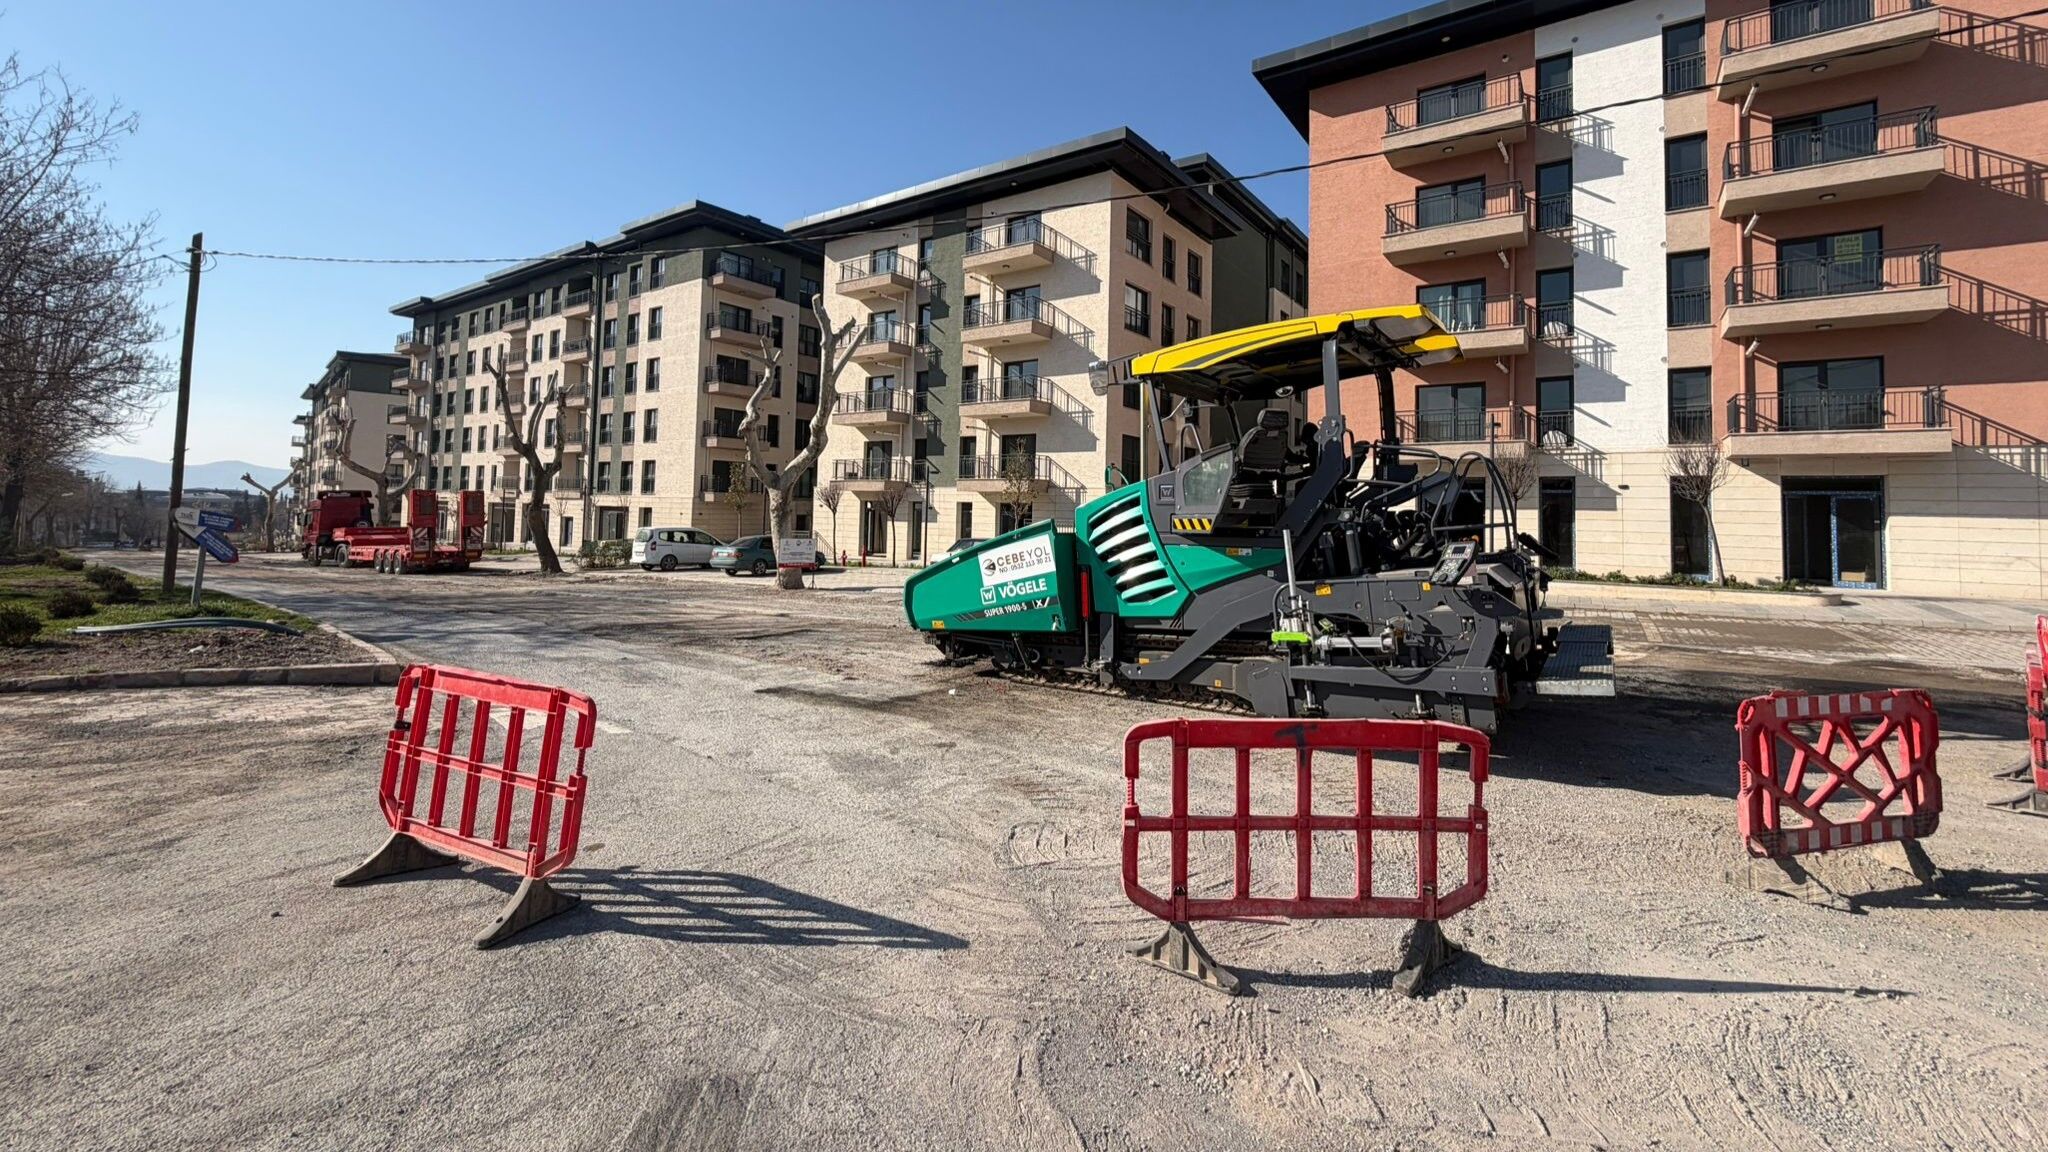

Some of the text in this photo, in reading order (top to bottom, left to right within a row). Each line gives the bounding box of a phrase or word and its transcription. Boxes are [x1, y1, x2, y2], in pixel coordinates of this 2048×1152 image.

[996, 546, 1050, 567] CEBE YOL
[998, 578, 1048, 599] VÖGELE
[983, 605, 1005, 618] SUPER
